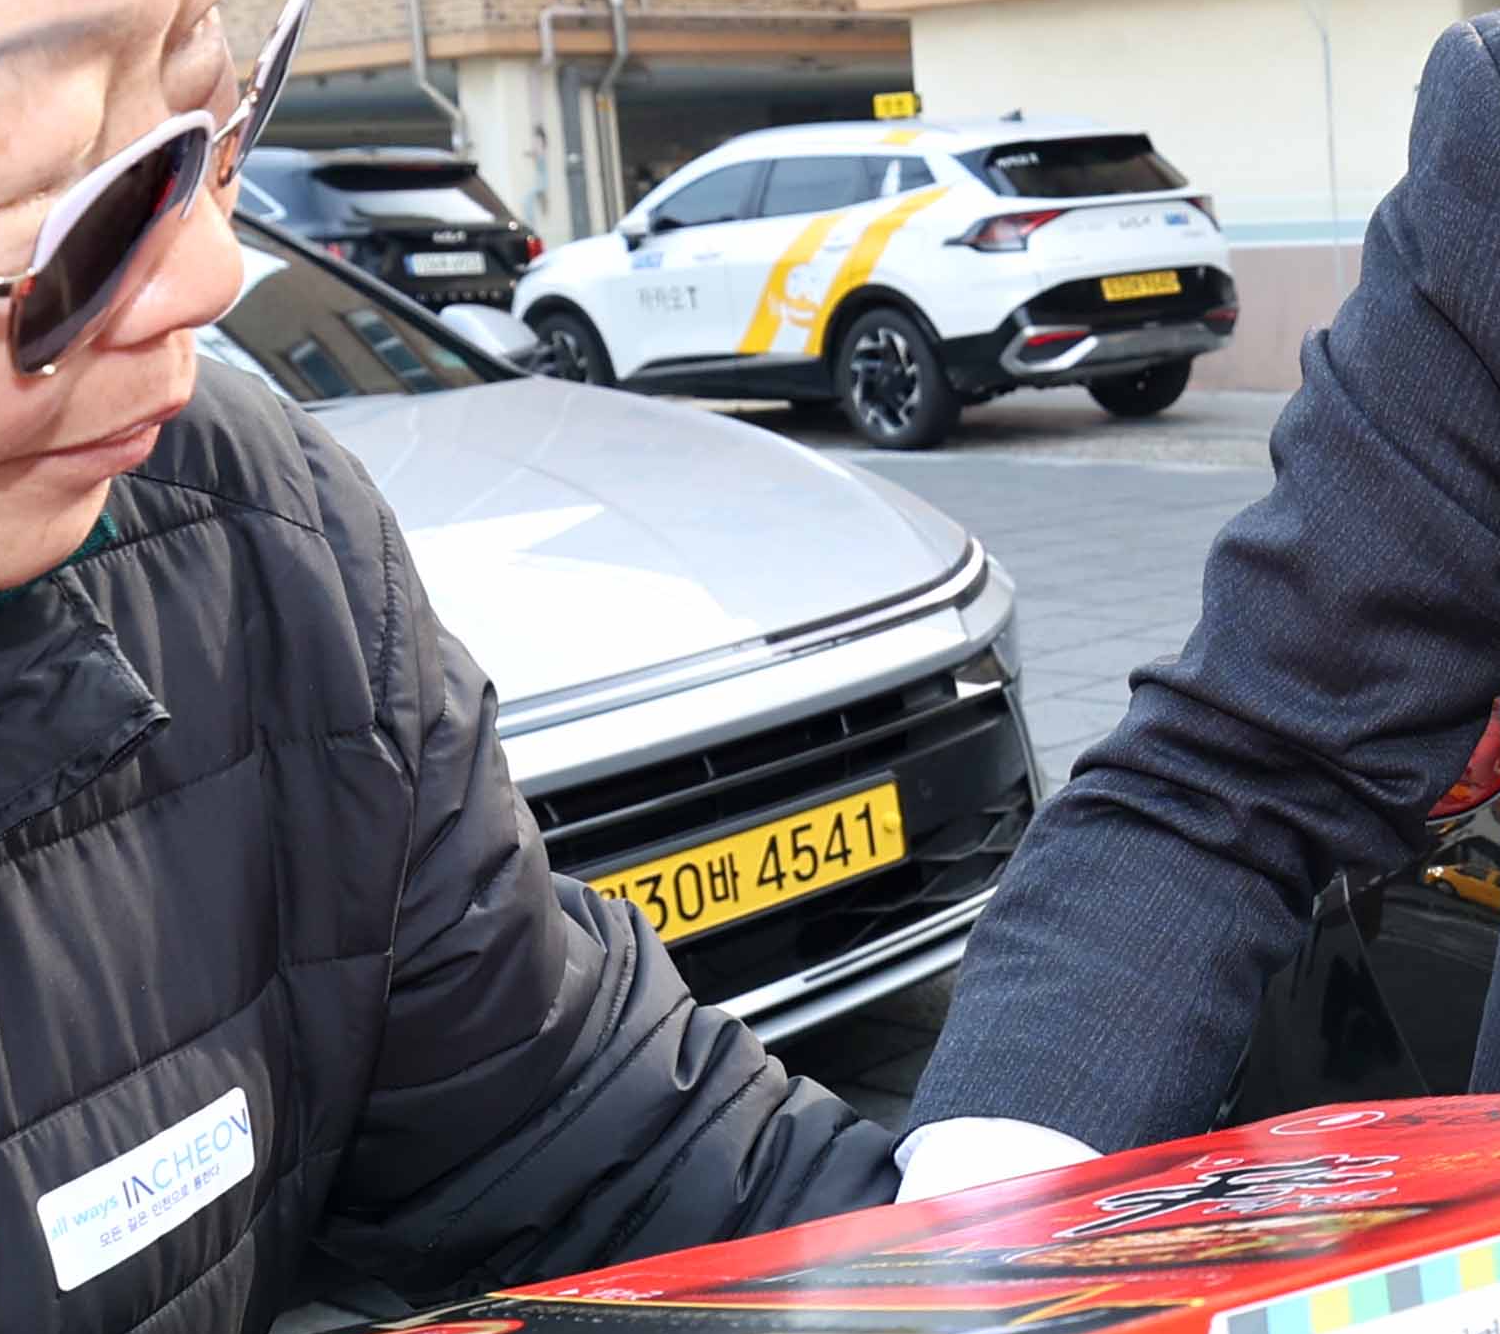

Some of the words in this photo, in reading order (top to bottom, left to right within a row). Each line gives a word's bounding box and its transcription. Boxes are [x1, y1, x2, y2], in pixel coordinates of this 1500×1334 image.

[756, 802, 877, 891] 4541
[73, 1194, 119, 1227] ways
[99, 1225, 124, 1248] 모든
[151, 1184, 190, 1217] 인천으로
[194, 1163, 221, 1191] 통한다
